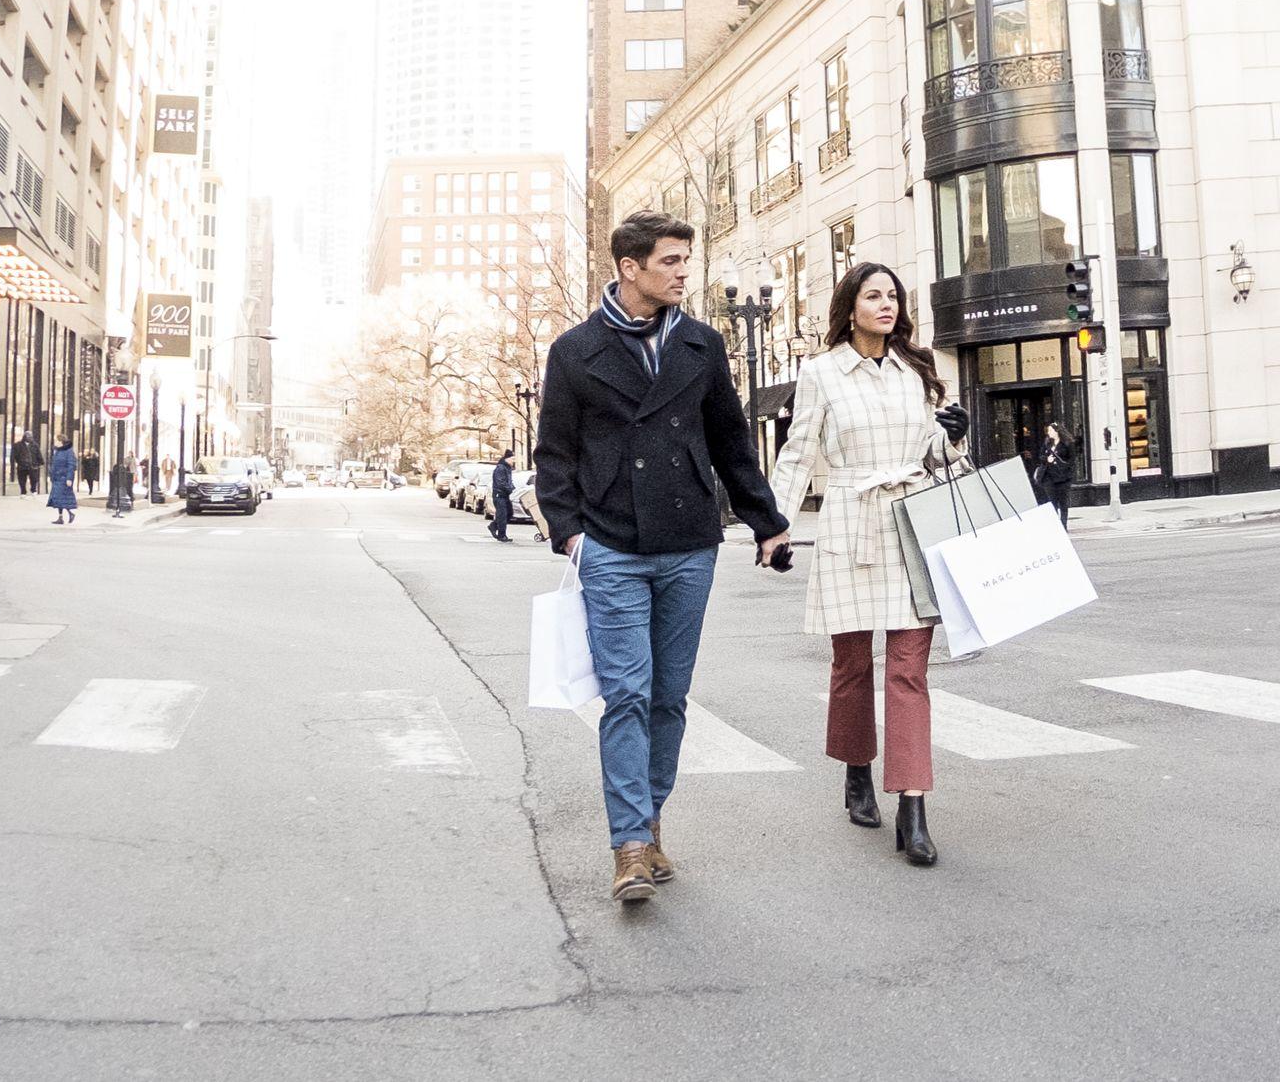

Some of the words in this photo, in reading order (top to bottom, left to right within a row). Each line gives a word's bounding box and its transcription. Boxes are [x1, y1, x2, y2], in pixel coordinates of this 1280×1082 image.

[158, 107, 195, 121] SELF
[156, 119, 196, 133] PARK
[148, 303, 190, 324] 900
[963, 310, 990, 320] MARC
[993, 304, 1039, 316] JACOBS
[148, 327, 166, 335] SELF
[168, 327, 190, 336] PARK
[988, 360, 1012, 368] MARC
[1022, 355, 1056, 365] JACOBS
[108, 406, 129, 414] ENTER
[982, 571, 1013, 589] MARC
[1018, 551, 1062, 577] JACOBS
